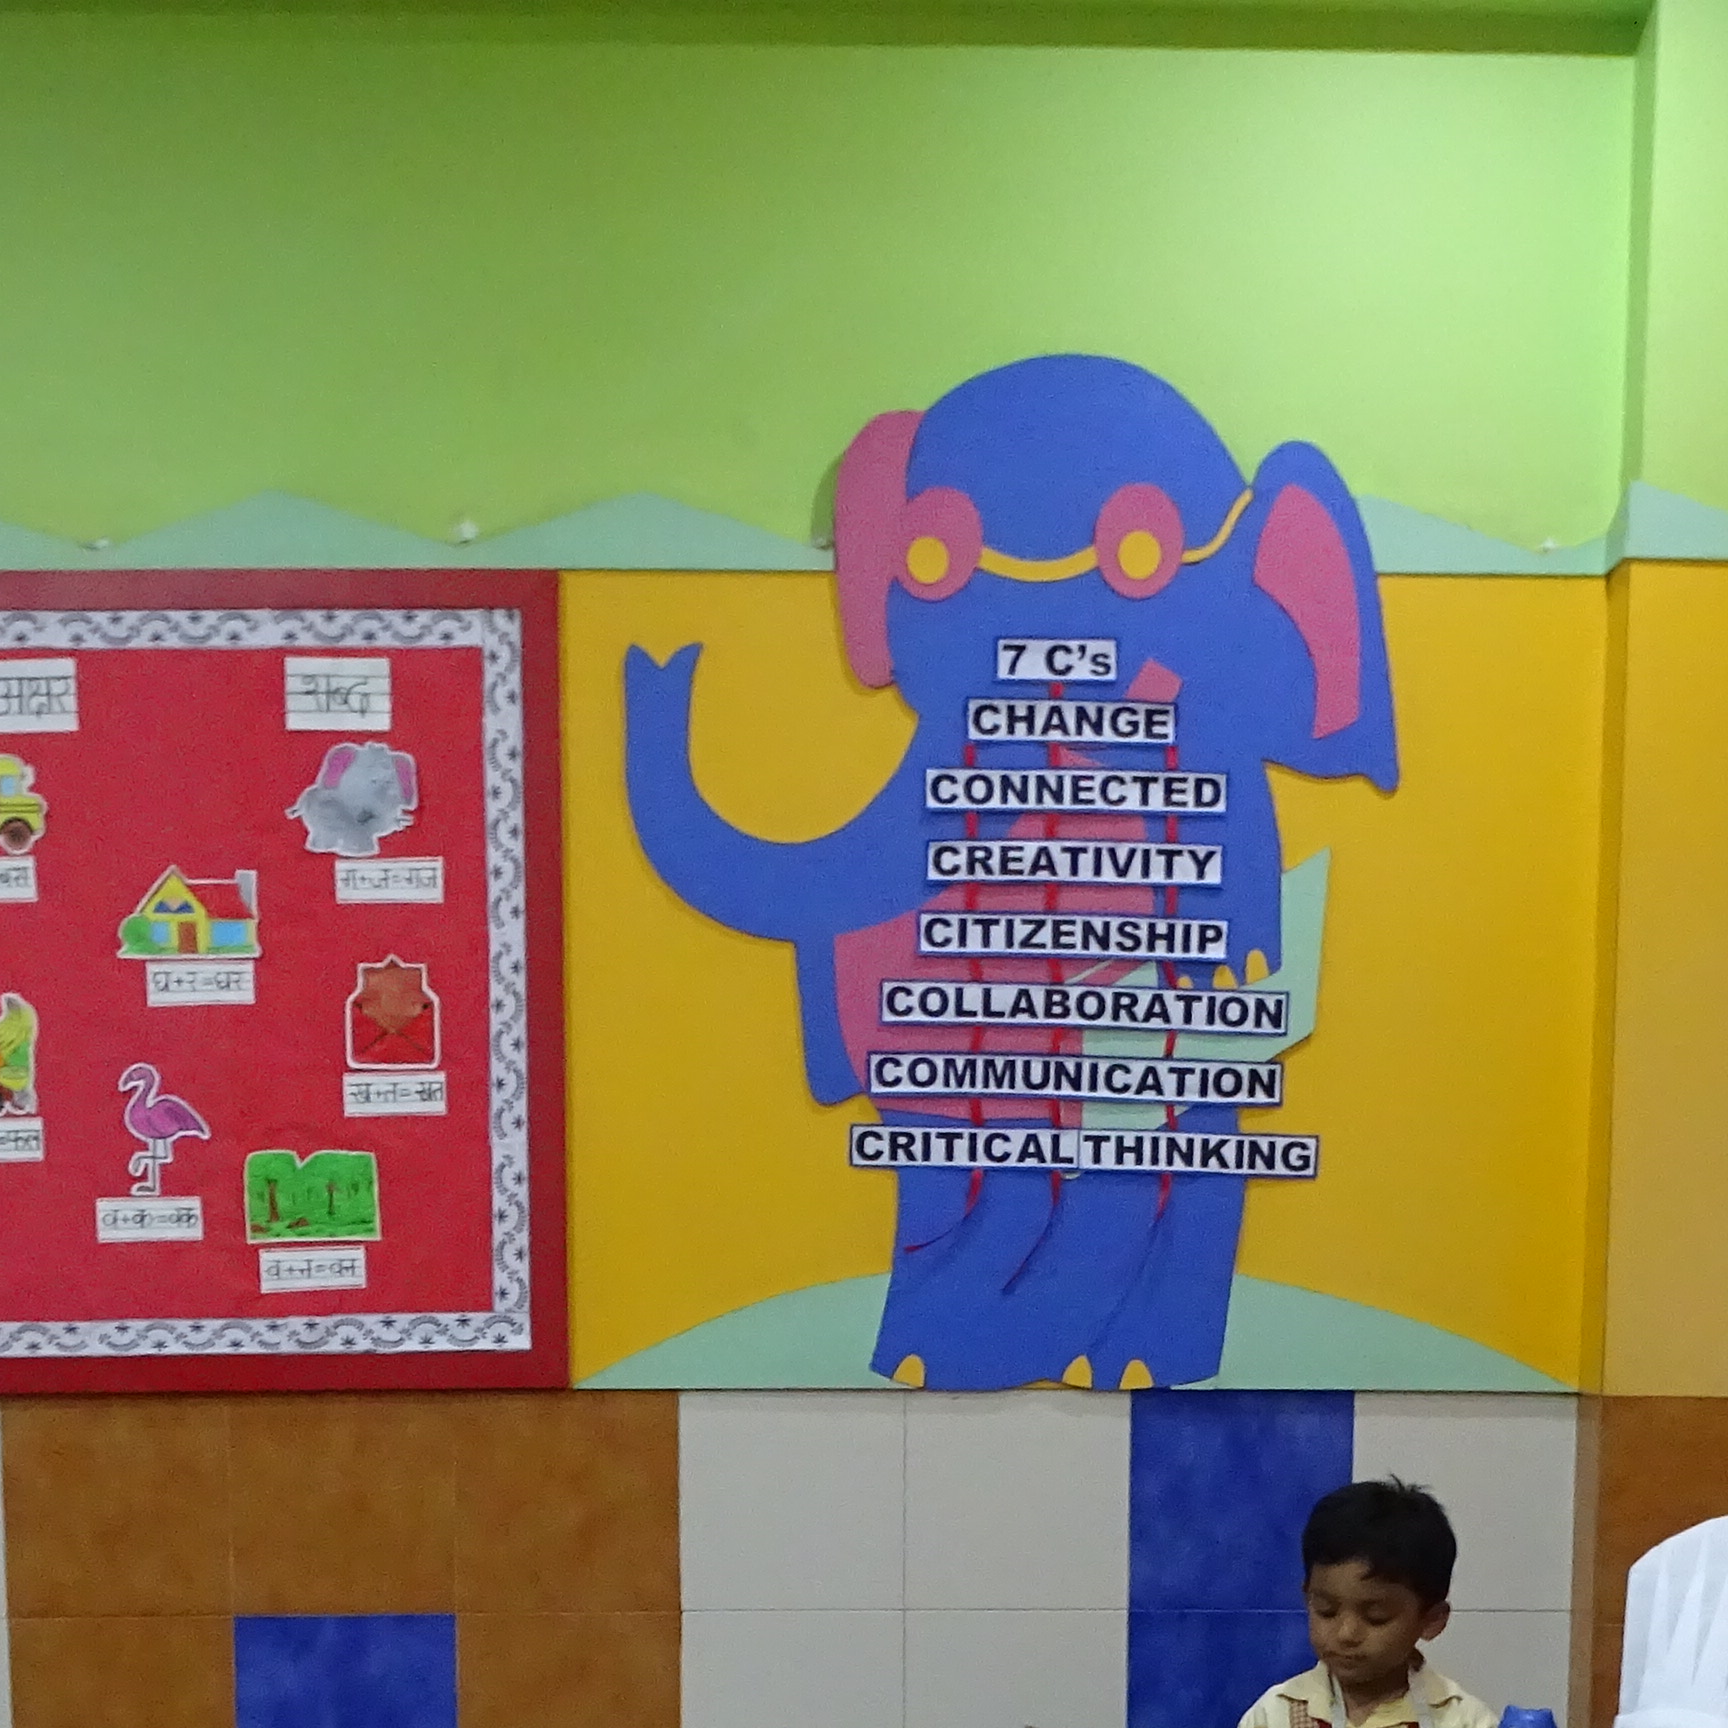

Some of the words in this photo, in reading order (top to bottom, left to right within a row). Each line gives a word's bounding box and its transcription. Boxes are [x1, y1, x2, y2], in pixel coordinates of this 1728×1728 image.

[1003, 644, 1027, 677] 7
[1045, 643, 1113, 678] C's
[972, 704, 1172, 740] CHANGE
[929, 773, 1222, 809] CONNECTED
[932, 845, 1216, 881] CREATIVITY
[923, 916, 1224, 955] CITIZENSHIP
[884, 984, 1285, 1030] COLLABORATION
[873, 1056, 1277, 1099] COMMUNICATION
[854, 1131, 1075, 1166] CRITICAL
[1083, 1134, 1313, 1173] THINKING
